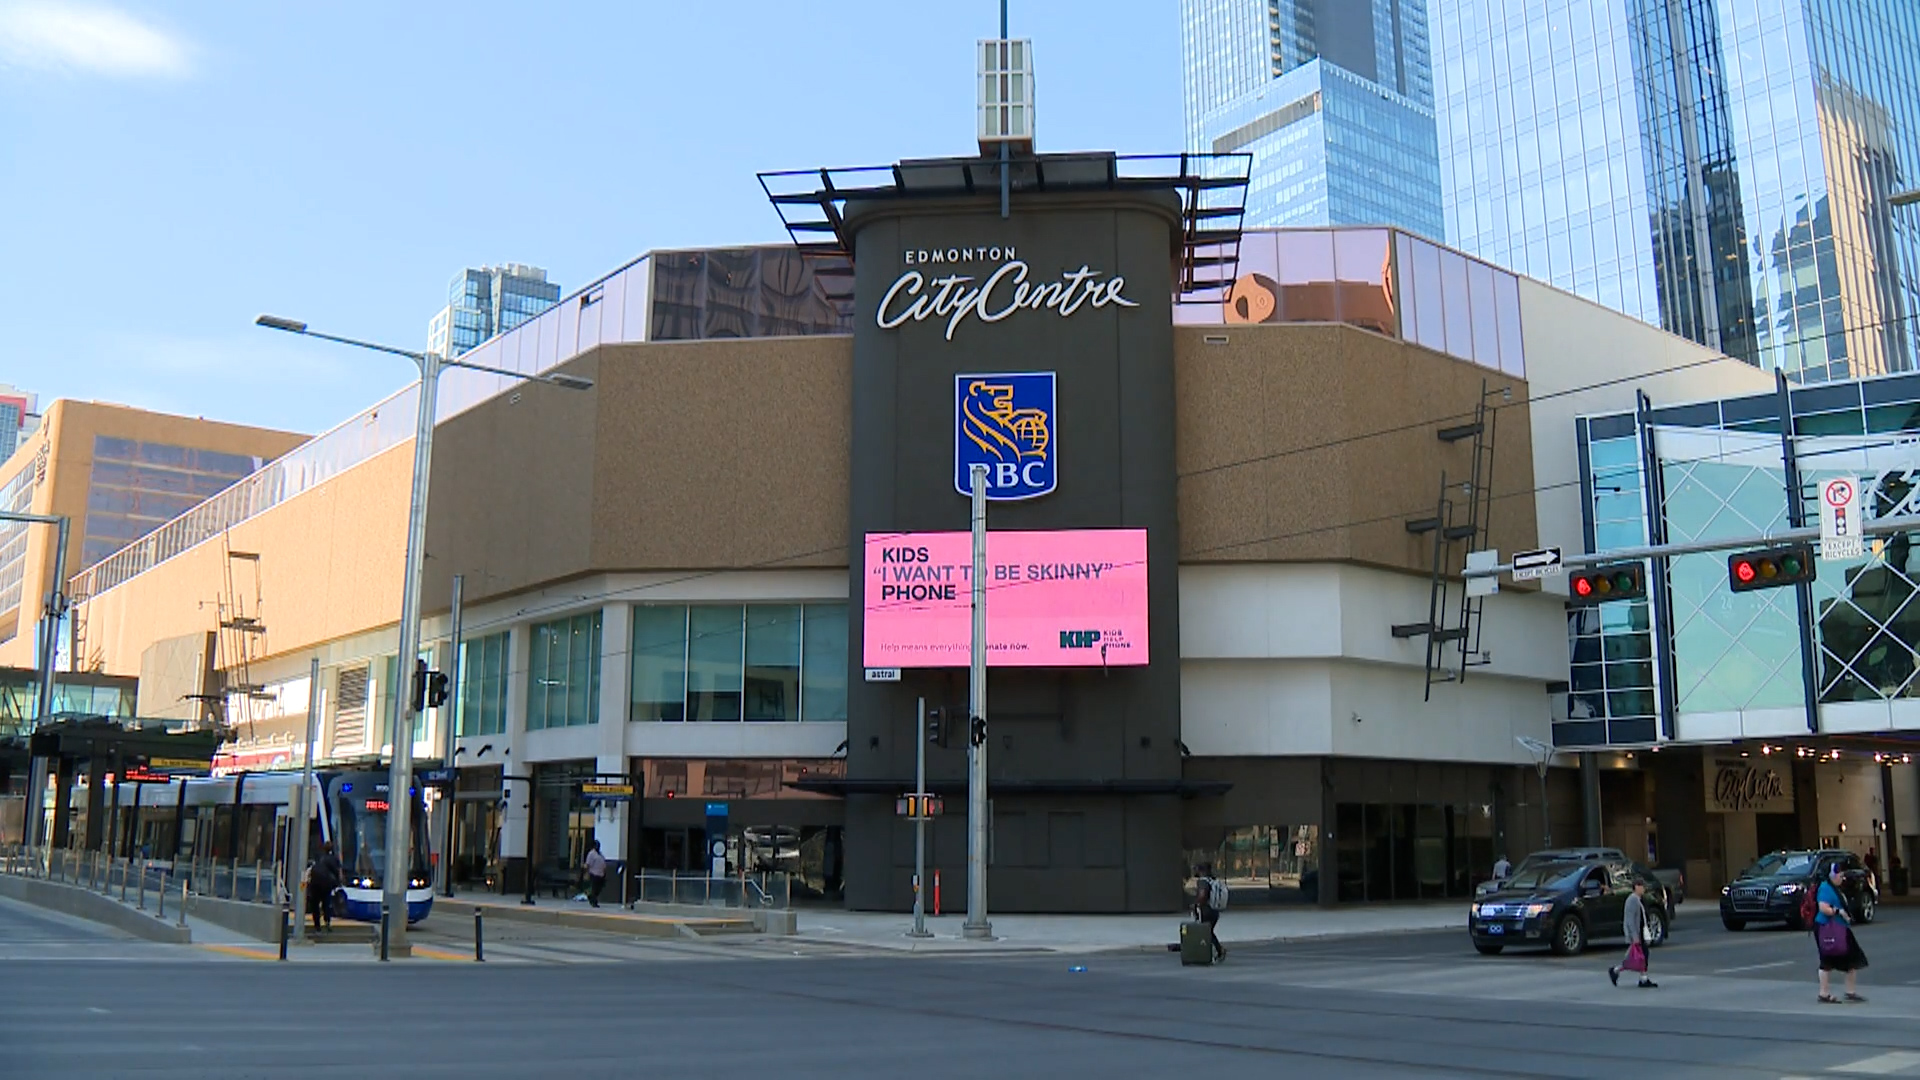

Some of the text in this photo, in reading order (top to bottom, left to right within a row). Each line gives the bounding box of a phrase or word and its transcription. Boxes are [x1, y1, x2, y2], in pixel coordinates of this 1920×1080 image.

[905, 246, 1016, 265] EDMONTON
[967, 461, 1045, 489] RBC
[882, 546, 929, 563] KIDS
[1825, 547, 1860, 558] BICYCLES
[893, 565, 955, 582] WANT
[959, 564, 988, 580] T
[994, 564, 1021, 580] BE
[882, 584, 956, 601] PHONE
[1059, 630, 1101, 648] KHP
[880, 643, 899, 653] Help
[901, 644, 928, 652] means
[871, 670, 895, 679] astral
